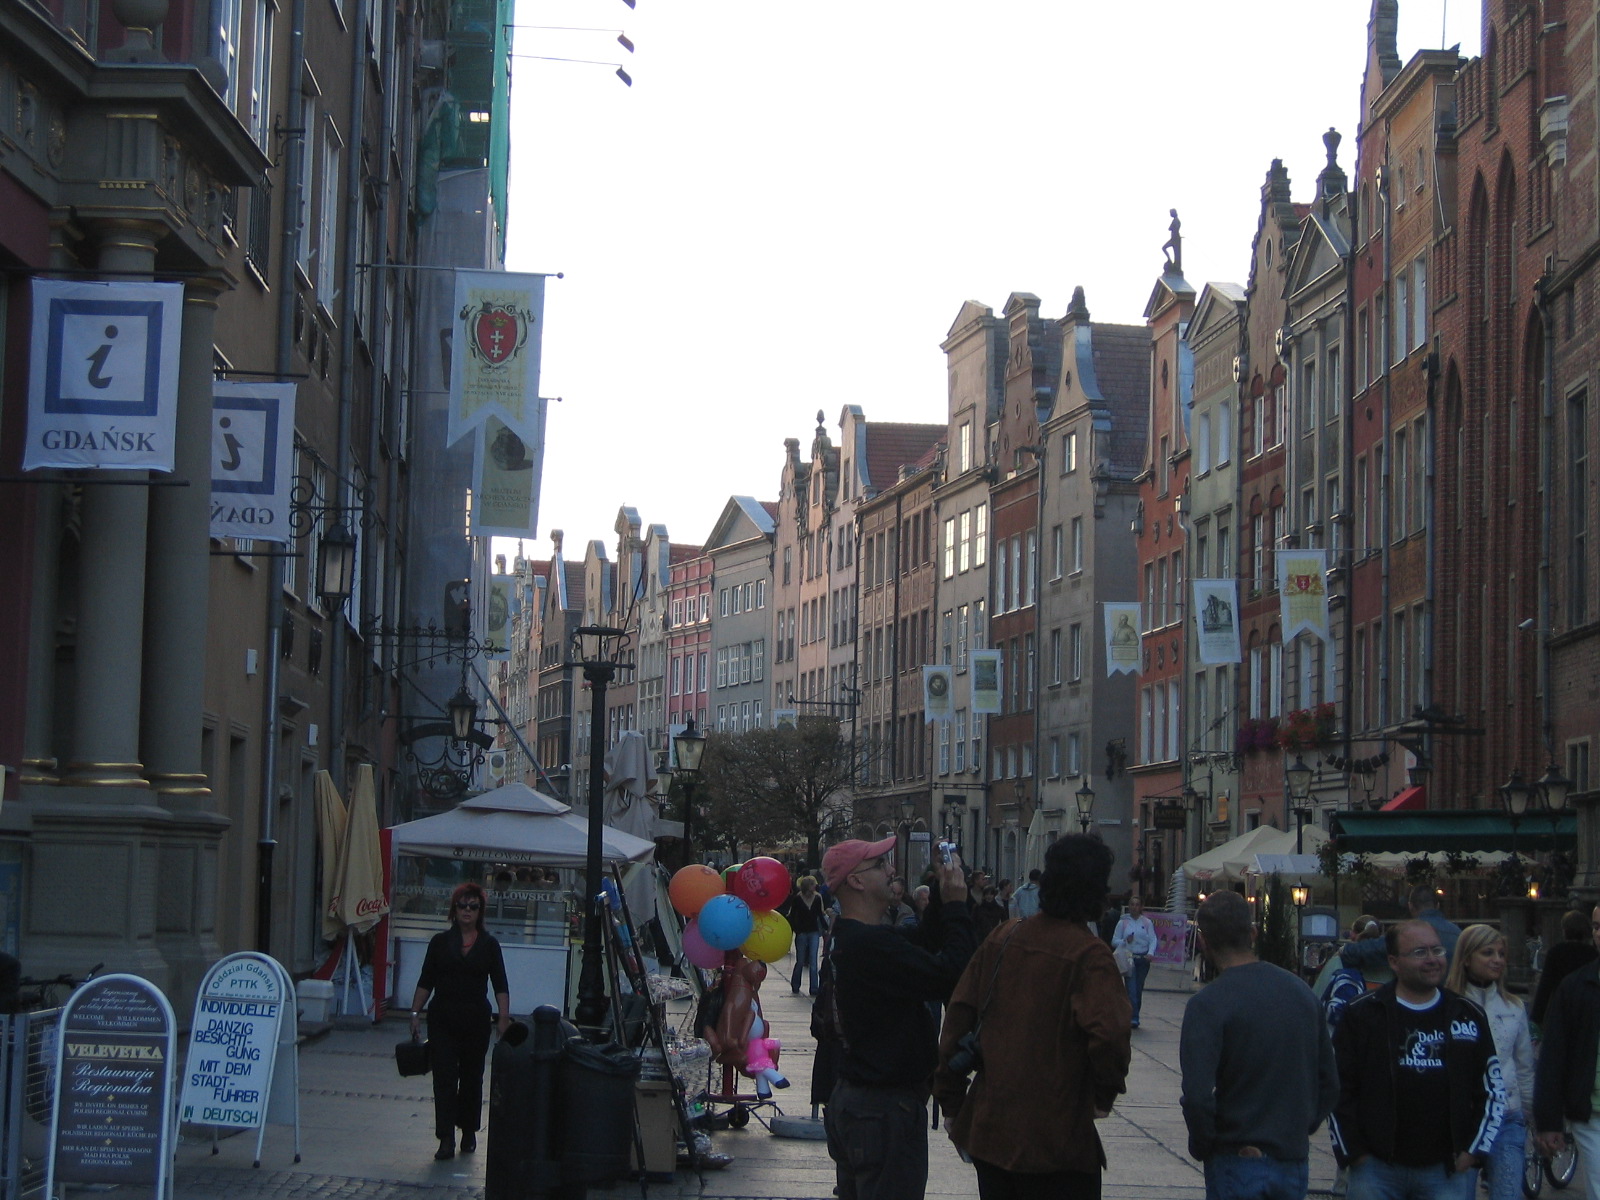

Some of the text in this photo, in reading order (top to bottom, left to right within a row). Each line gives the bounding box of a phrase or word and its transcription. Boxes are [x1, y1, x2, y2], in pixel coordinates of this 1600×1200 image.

[42, 425, 156, 453] GDAŃSK
[468, 849, 532, 861] PELLOWSKI
[230, 979, 258, 989] PTTK
[201, 1000, 277, 1018] INDIVIDUELLE
[208, 1019, 254, 1035] DANZIG
[1450, 1020, 1478, 1037] D&G
[195, 1030, 252, 1048] BESICHTI-
[66, 1043, 164, 1059] VELEVETKA
[226, 1045, 261, 1061] GUNG
[1411, 1041, 1425, 1056] &
[72, 1062, 155, 1081] Restauracja
[199, 1059, 252, 1076] MIT DEM
[72, 1078, 153, 1096] Regionalna
[191, 1074, 235, 1088] STADT-
[184, 1105, 259, 1124] IN DEUTSCH
[61, 1129, 92, 1137] POLNISCHE
